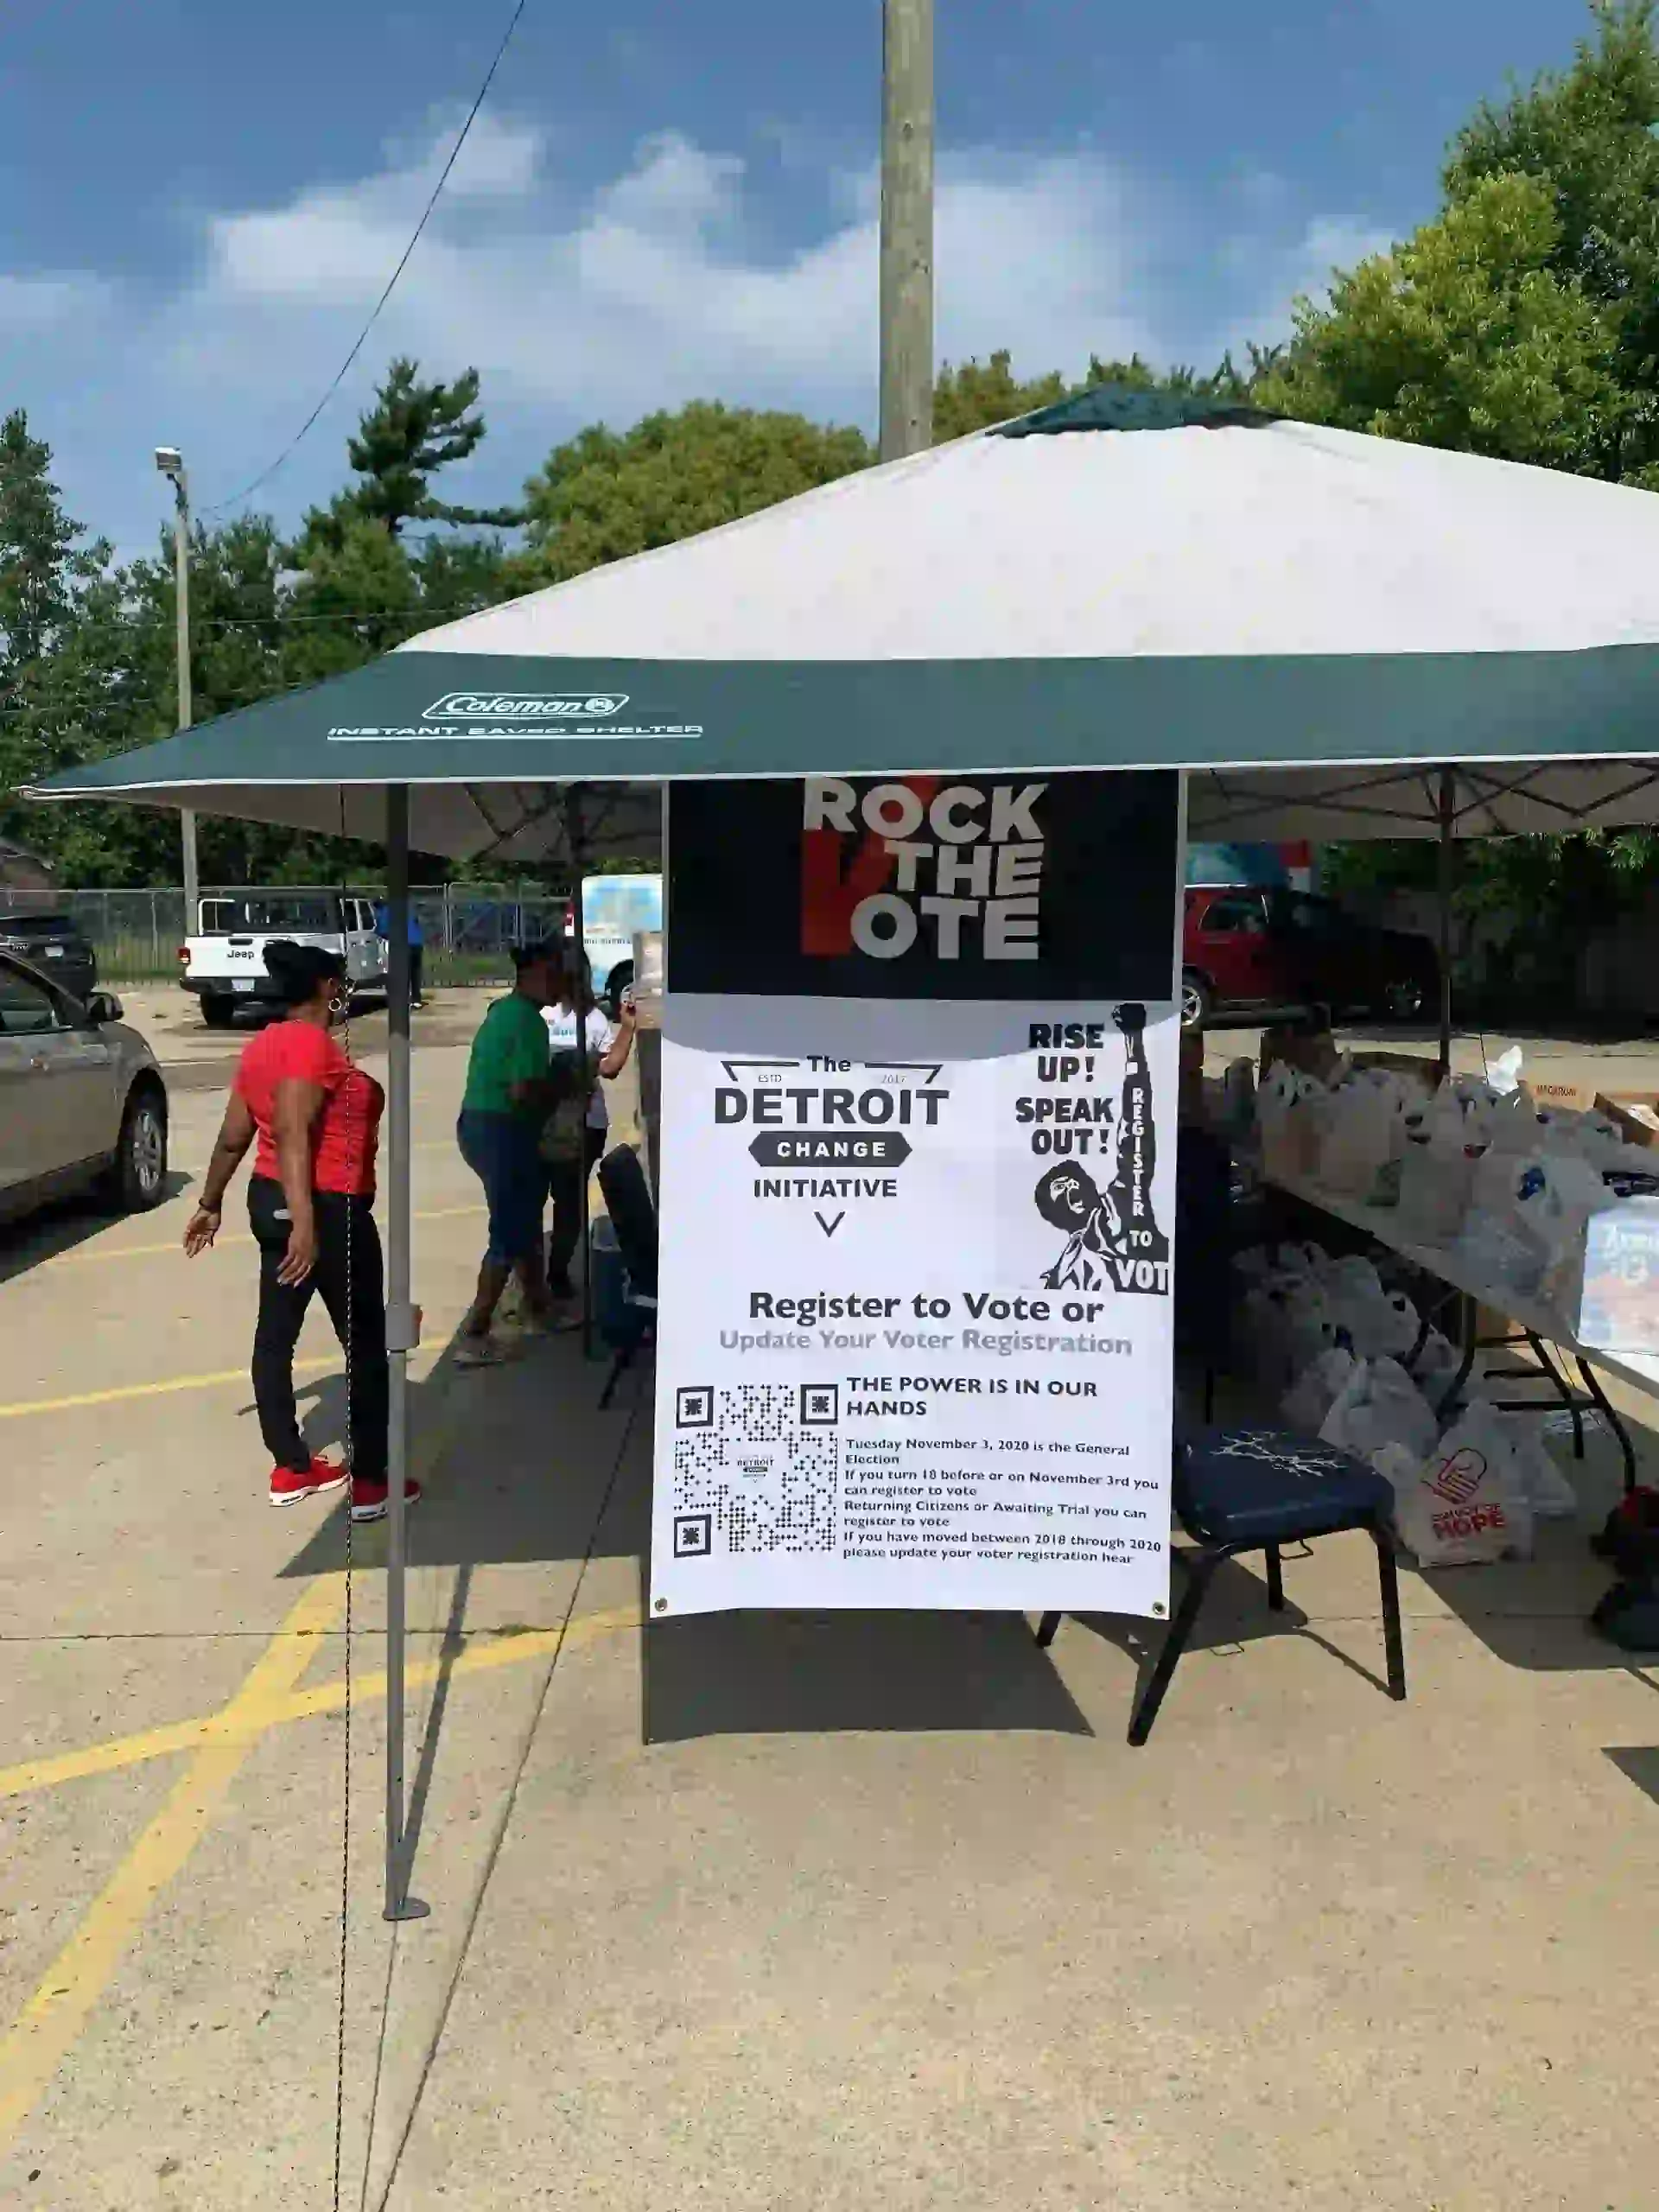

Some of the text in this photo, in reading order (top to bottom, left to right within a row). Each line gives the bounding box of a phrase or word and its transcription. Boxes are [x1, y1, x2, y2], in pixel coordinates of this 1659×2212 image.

[446, 697, 583, 713] Coleman
[804, 779, 1050, 843] ROCK
[885, 840, 1044, 896] THE
[227, 950, 254, 959] Jeep
[1029, 1023, 1105, 1048] RISE
[807, 1056, 851, 1071] The
[1038, 1056, 1094, 1082] UP!
[881, 1075, 906, 1084] 2017
[715, 1088, 950, 1124] DETROIT
[1016, 1097, 1114, 1123] SPEAK
[778, 1142, 885, 1157] CHANGE
[1032, 1128, 1109, 1154] OUT!
[1132, 1087, 1145, 1217] REGISTER
[754, 1179, 896, 1198] INITIATIVE
[1129, 1230, 1153, 1247] TO
[750, 1292, 1104, 1326] Register to Vote or
[721, 1329, 1132, 1357] Update Your Voter Registration
[847, 1377, 1096, 1396] THE POWER IS IN OUR
[847, 1402, 926, 1416] HANDS
[847, 1440, 901, 1452] Tuesday
[906, 1439, 976, 1448] November
[983, 1440, 992, 1450] 3,
[999, 1440, 1029, 1451] 2020
[1049, 1442, 1071, 1452] the
[1076, 1444, 1128, 1455] General
[846, 1455, 899, 1464] Election
[846, 1470, 855, 1479] If
[860, 1472, 883, 1483] you
[941, 1470, 984, 1479] before
[1030, 1472, 1103, 1484] November
[1108, 1476, 1128, 1486] 3rd
[1134, 1480, 1158, 1490] you
[872, 1486, 924, 1497] register
[947, 1487, 976, 1496] vote
[845, 1501, 911, 1514] Returning
[916, 1501, 969, 1510] Citizens
[994, 1503, 1052, 1516] Awaiting
[1058, 1504, 1089, 1514] Trial
[1095, 1509, 1118, 1517] you
[844, 1517, 896, 1529] register
[844, 1531, 1160, 1552] If you have moved between 2018 through 2020
[844, 1548, 885, 1559] please
[890, 1548, 937, 1559] update
[942, 1550, 971, 1560] your
[977, 1550, 1013, 1559] voter
[1018, 1552, 1096, 1562] registration
